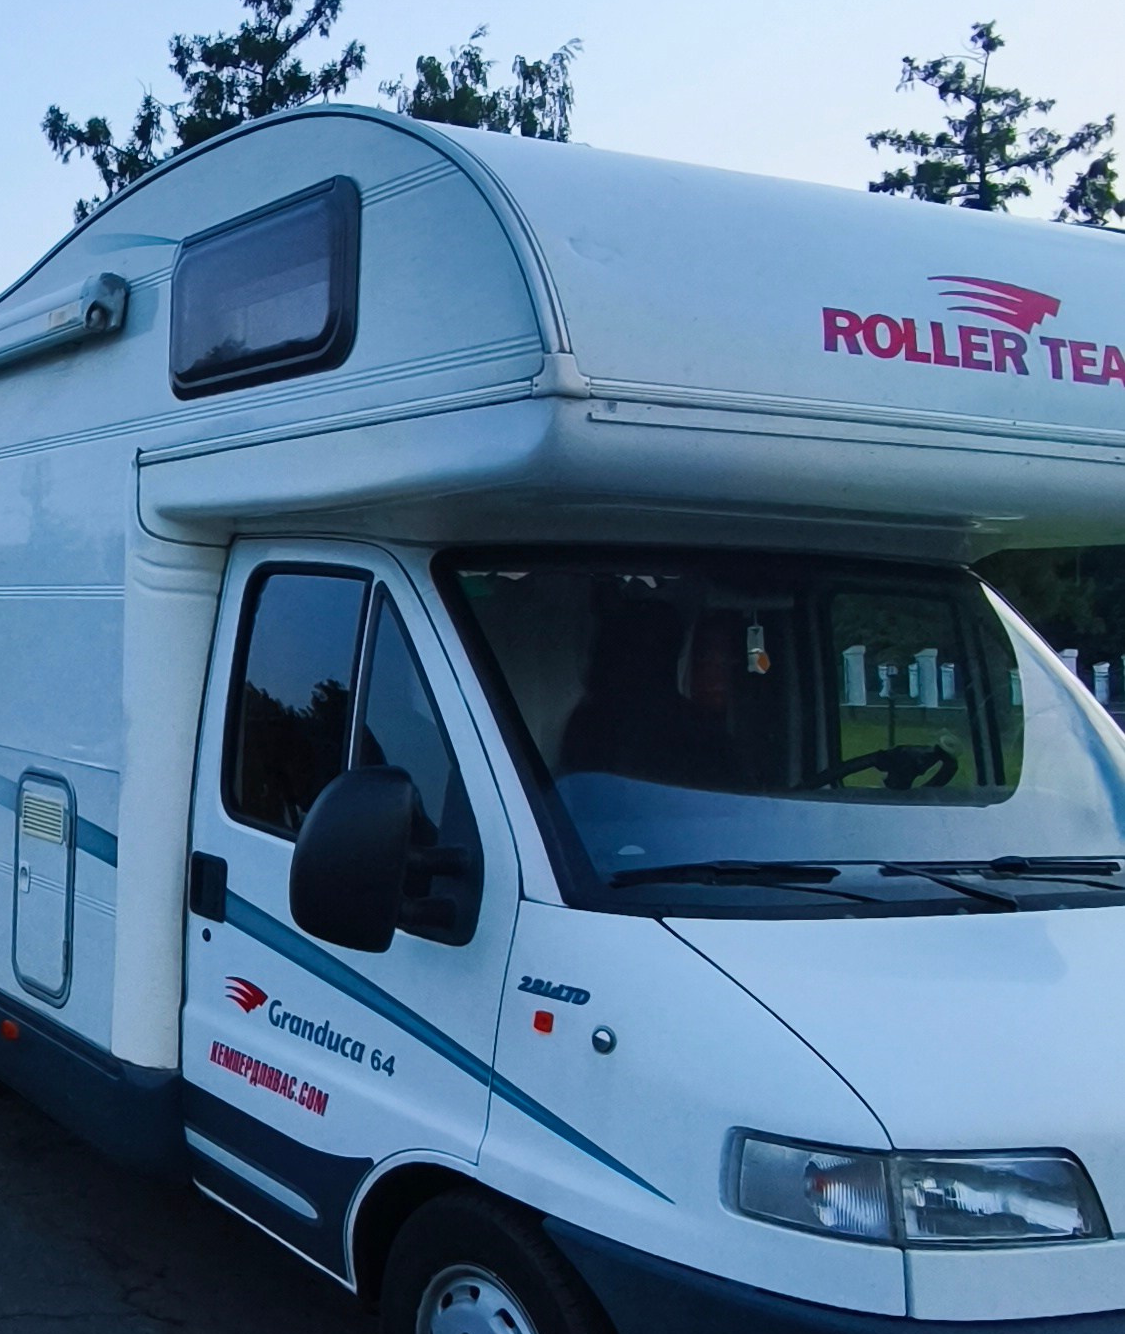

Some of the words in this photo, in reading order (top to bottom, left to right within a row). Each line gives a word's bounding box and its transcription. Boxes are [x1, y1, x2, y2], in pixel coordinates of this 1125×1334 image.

[822, 306, 1030, 376] ROLLER
[268, 999, 366, 1064] Granduca
[370, 1048, 395, 1077] 64
